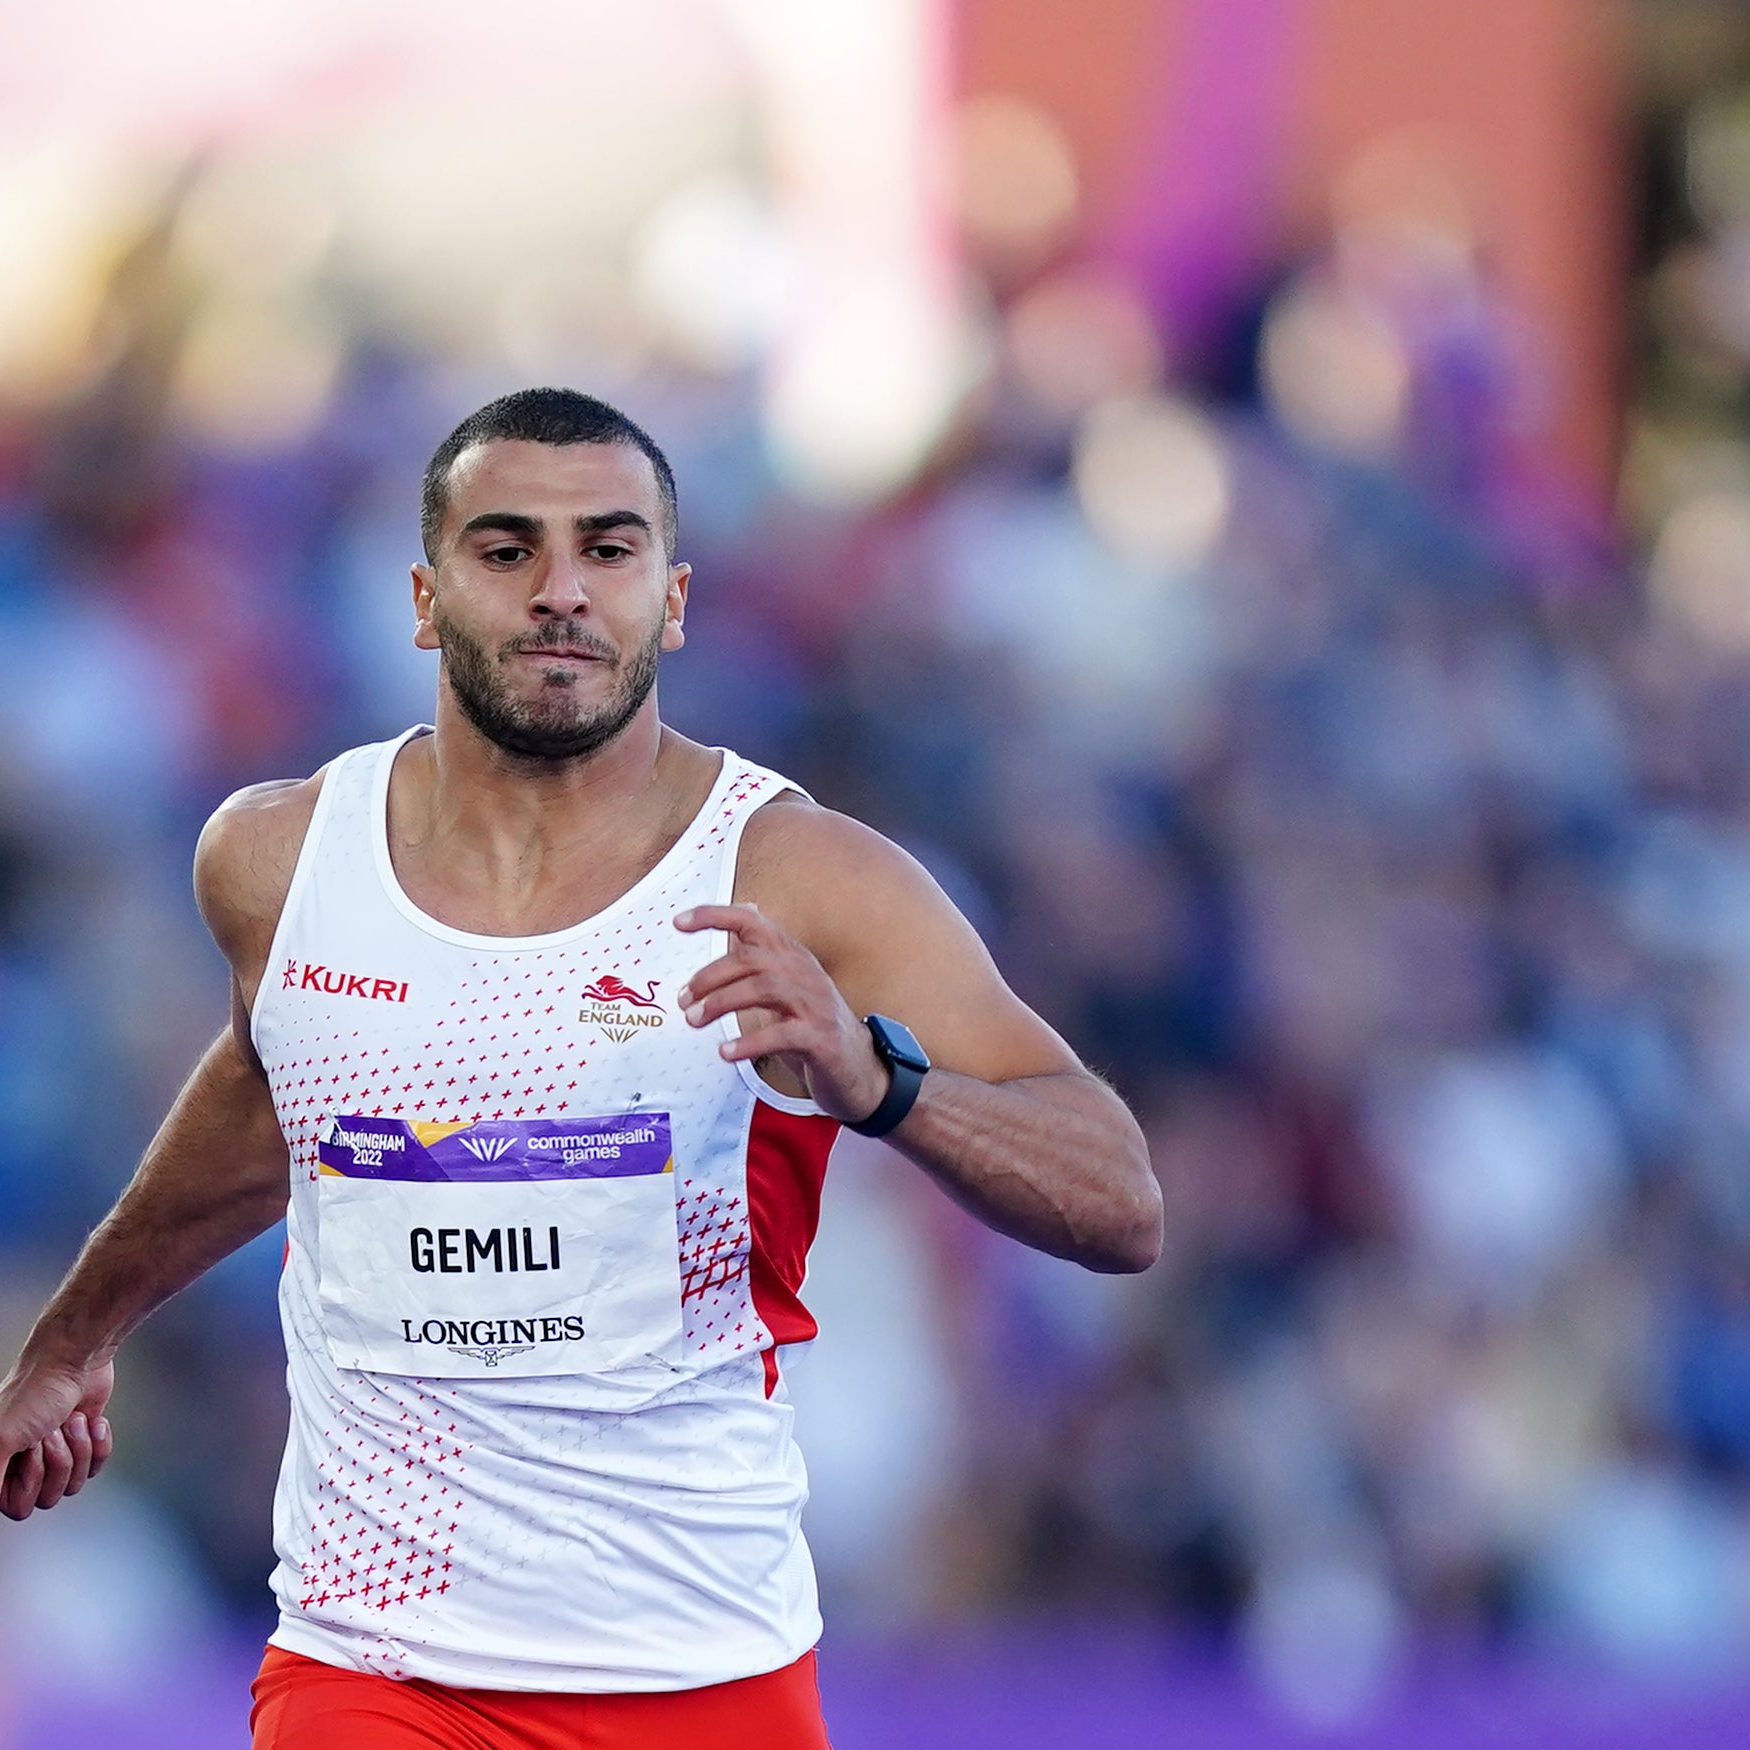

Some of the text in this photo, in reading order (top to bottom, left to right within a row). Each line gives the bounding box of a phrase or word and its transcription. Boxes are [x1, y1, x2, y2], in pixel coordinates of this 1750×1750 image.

[300, 964, 409, 1002] KUKRI
[591, 1001, 621, 1011] TEAM
[578, 1009, 664, 1027] ENGLAND
[332, 1131, 406, 1152] BIRMINGHAM
[527, 1128, 655, 1150] commonwealth
[353, 1148, 383, 1166] 2022
[562, 1146, 621, 1164] games
[410, 1226, 560, 1273] GEMILI
[400, 1315, 585, 1346] LONGINES
